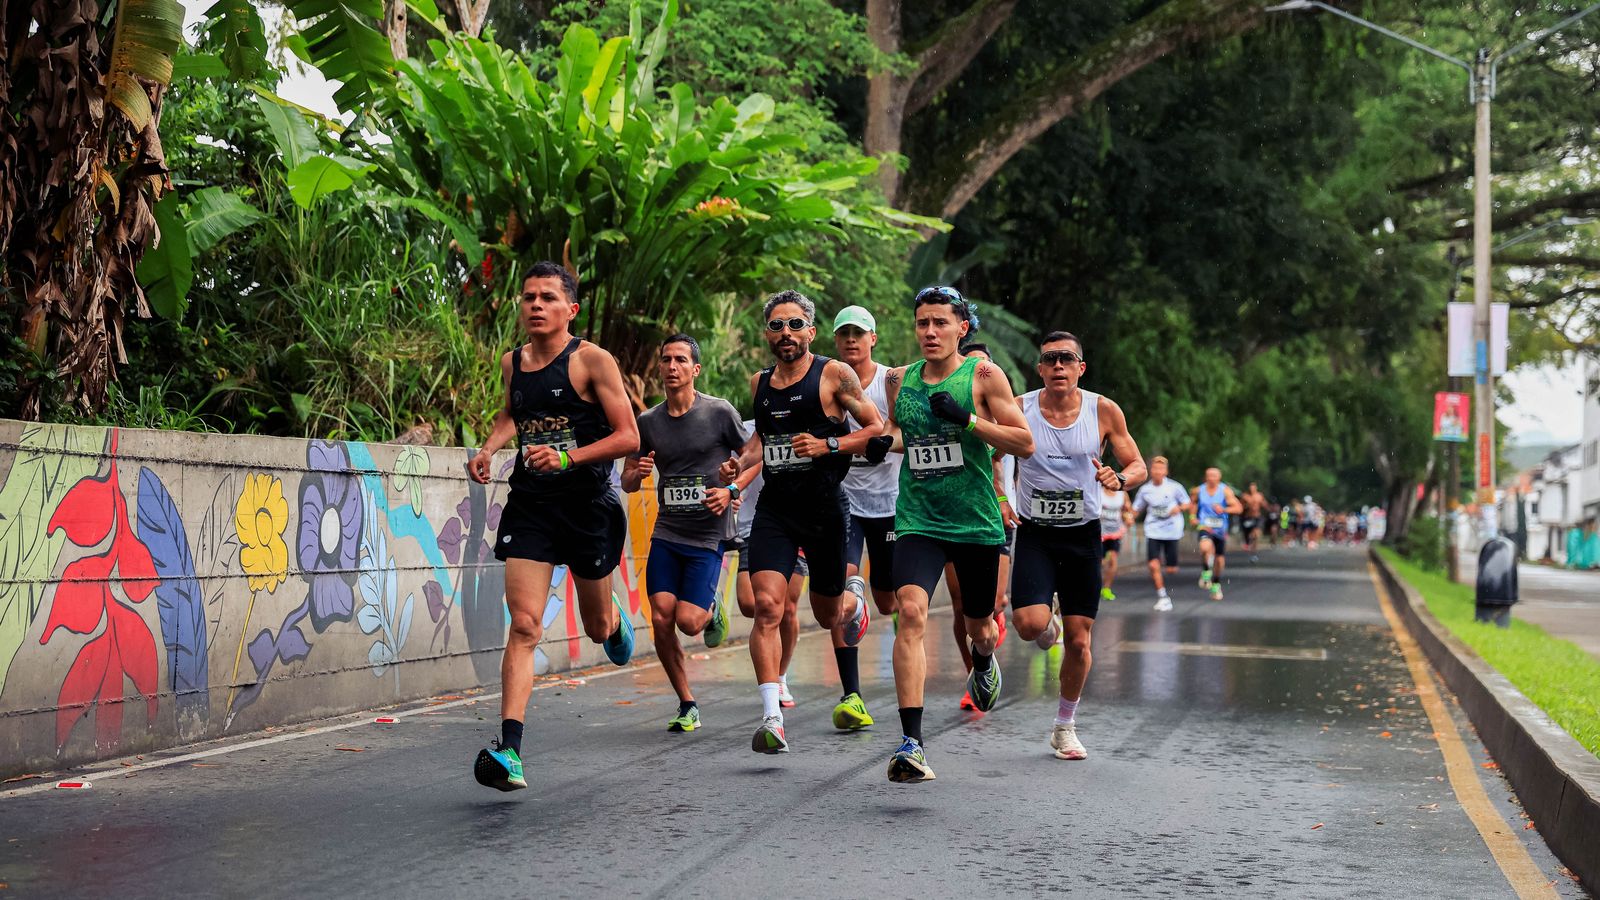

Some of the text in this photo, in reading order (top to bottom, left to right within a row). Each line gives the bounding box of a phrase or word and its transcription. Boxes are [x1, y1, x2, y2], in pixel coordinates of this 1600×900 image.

[769, 446, 800, 461] 117
[914, 446, 952, 464] 1311
[669, 488, 700, 501] 1396
[1040, 501, 1077, 515] 1252
